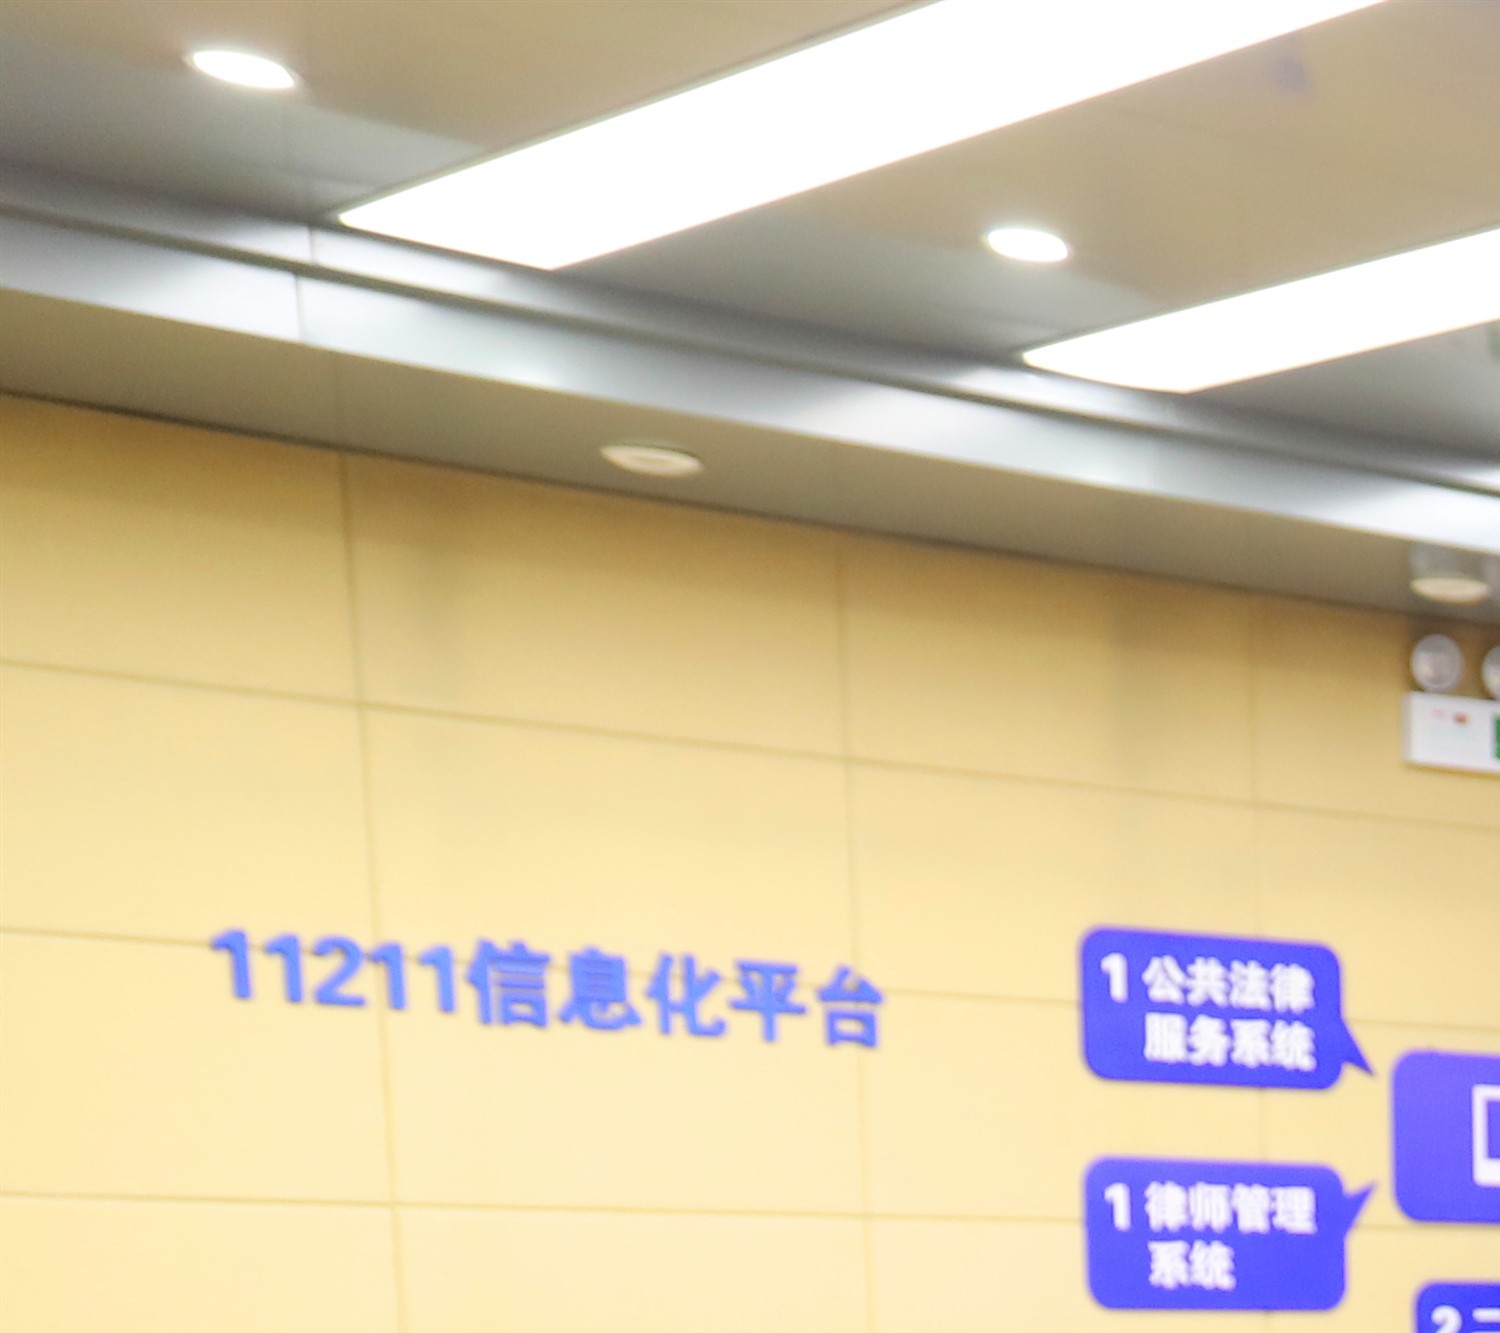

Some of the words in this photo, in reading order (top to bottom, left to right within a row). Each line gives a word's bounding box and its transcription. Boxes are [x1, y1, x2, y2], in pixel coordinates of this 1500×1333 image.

[210, 929, 884, 1048] 11211信息化平台
[1100, 952, 1129, 1003] 1
[1142, 954, 1315, 1013] 公共法律
[1143, 1012, 1317, 1072] 服务系统
[1104, 1182, 1132, 1232] 1
[1144, 1181, 1317, 1234] 律师管理
[1148, 1239, 1236, 1291] 系统
